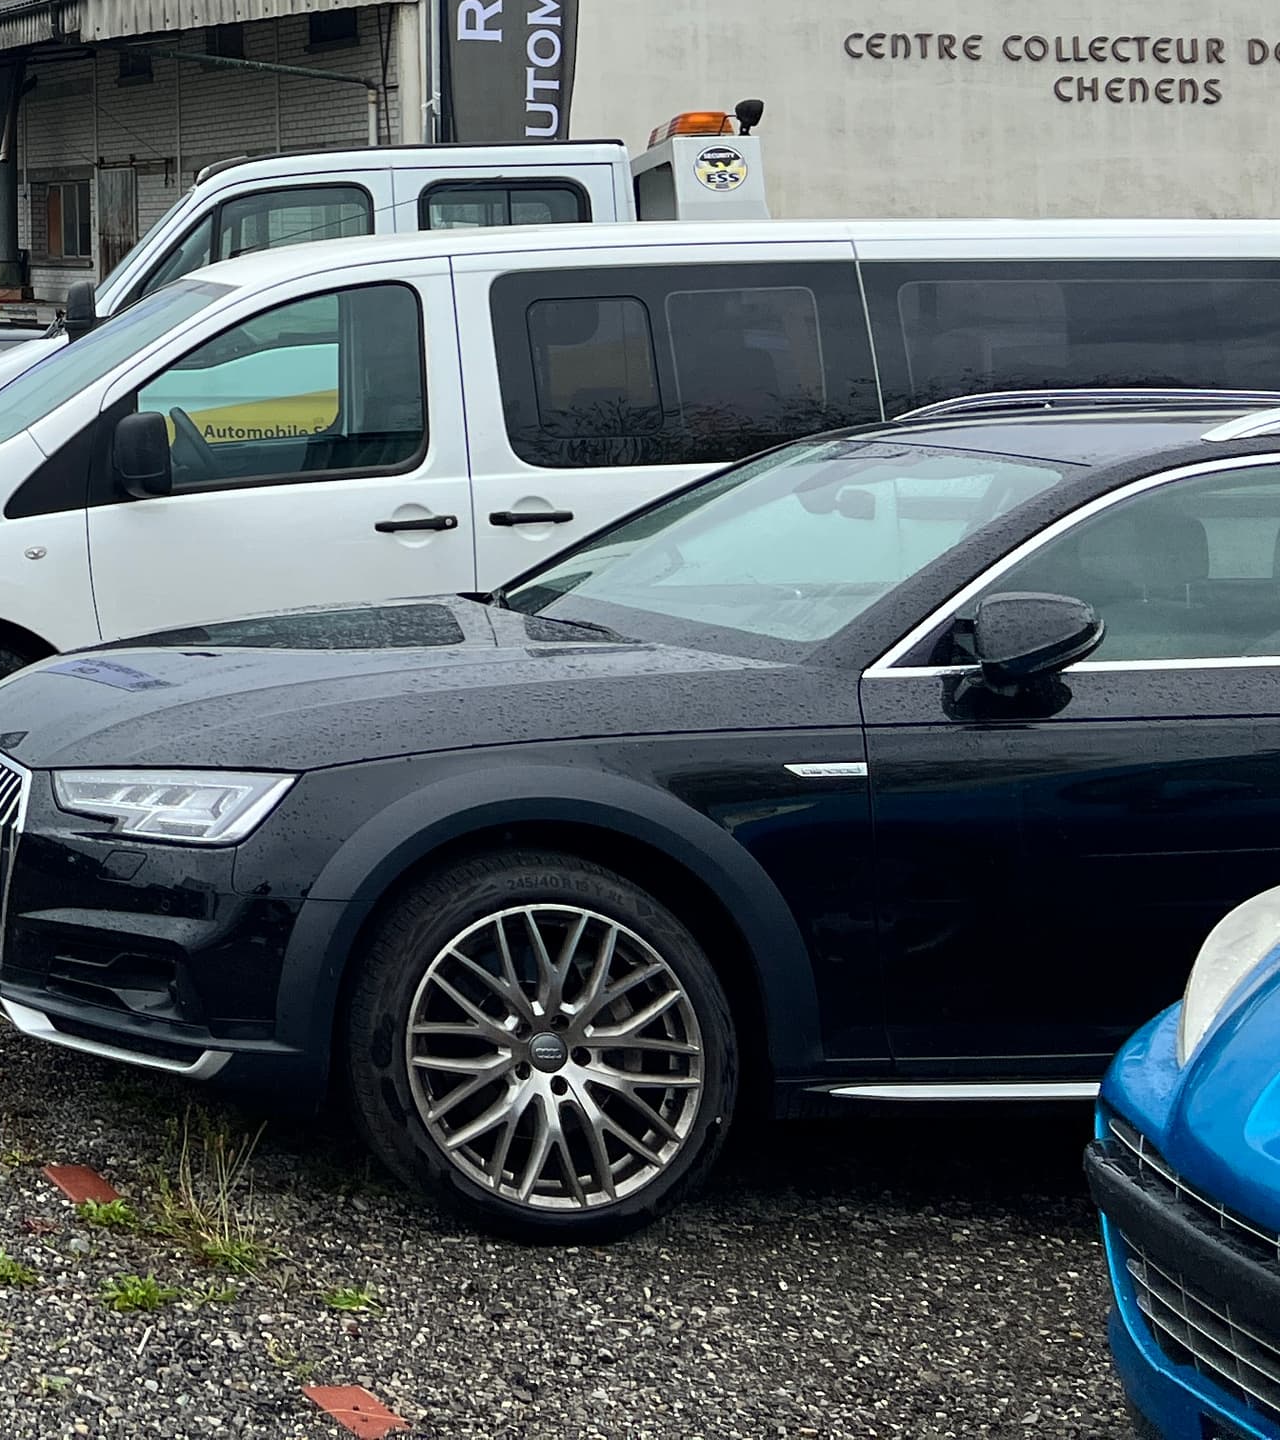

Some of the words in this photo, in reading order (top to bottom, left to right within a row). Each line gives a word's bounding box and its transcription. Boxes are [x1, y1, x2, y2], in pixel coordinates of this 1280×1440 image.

[843, 32, 984, 60] CENTRE
[1002, 34, 1227, 64] COLLECTEUR
[1247, 38, 1280, 66] D
[1053, 75, 1223, 105] CHENENS
[706, 172, 740, 184] ESS
[203, 424, 308, 439] Automobile
[506, 875, 561, 891] 245/40
